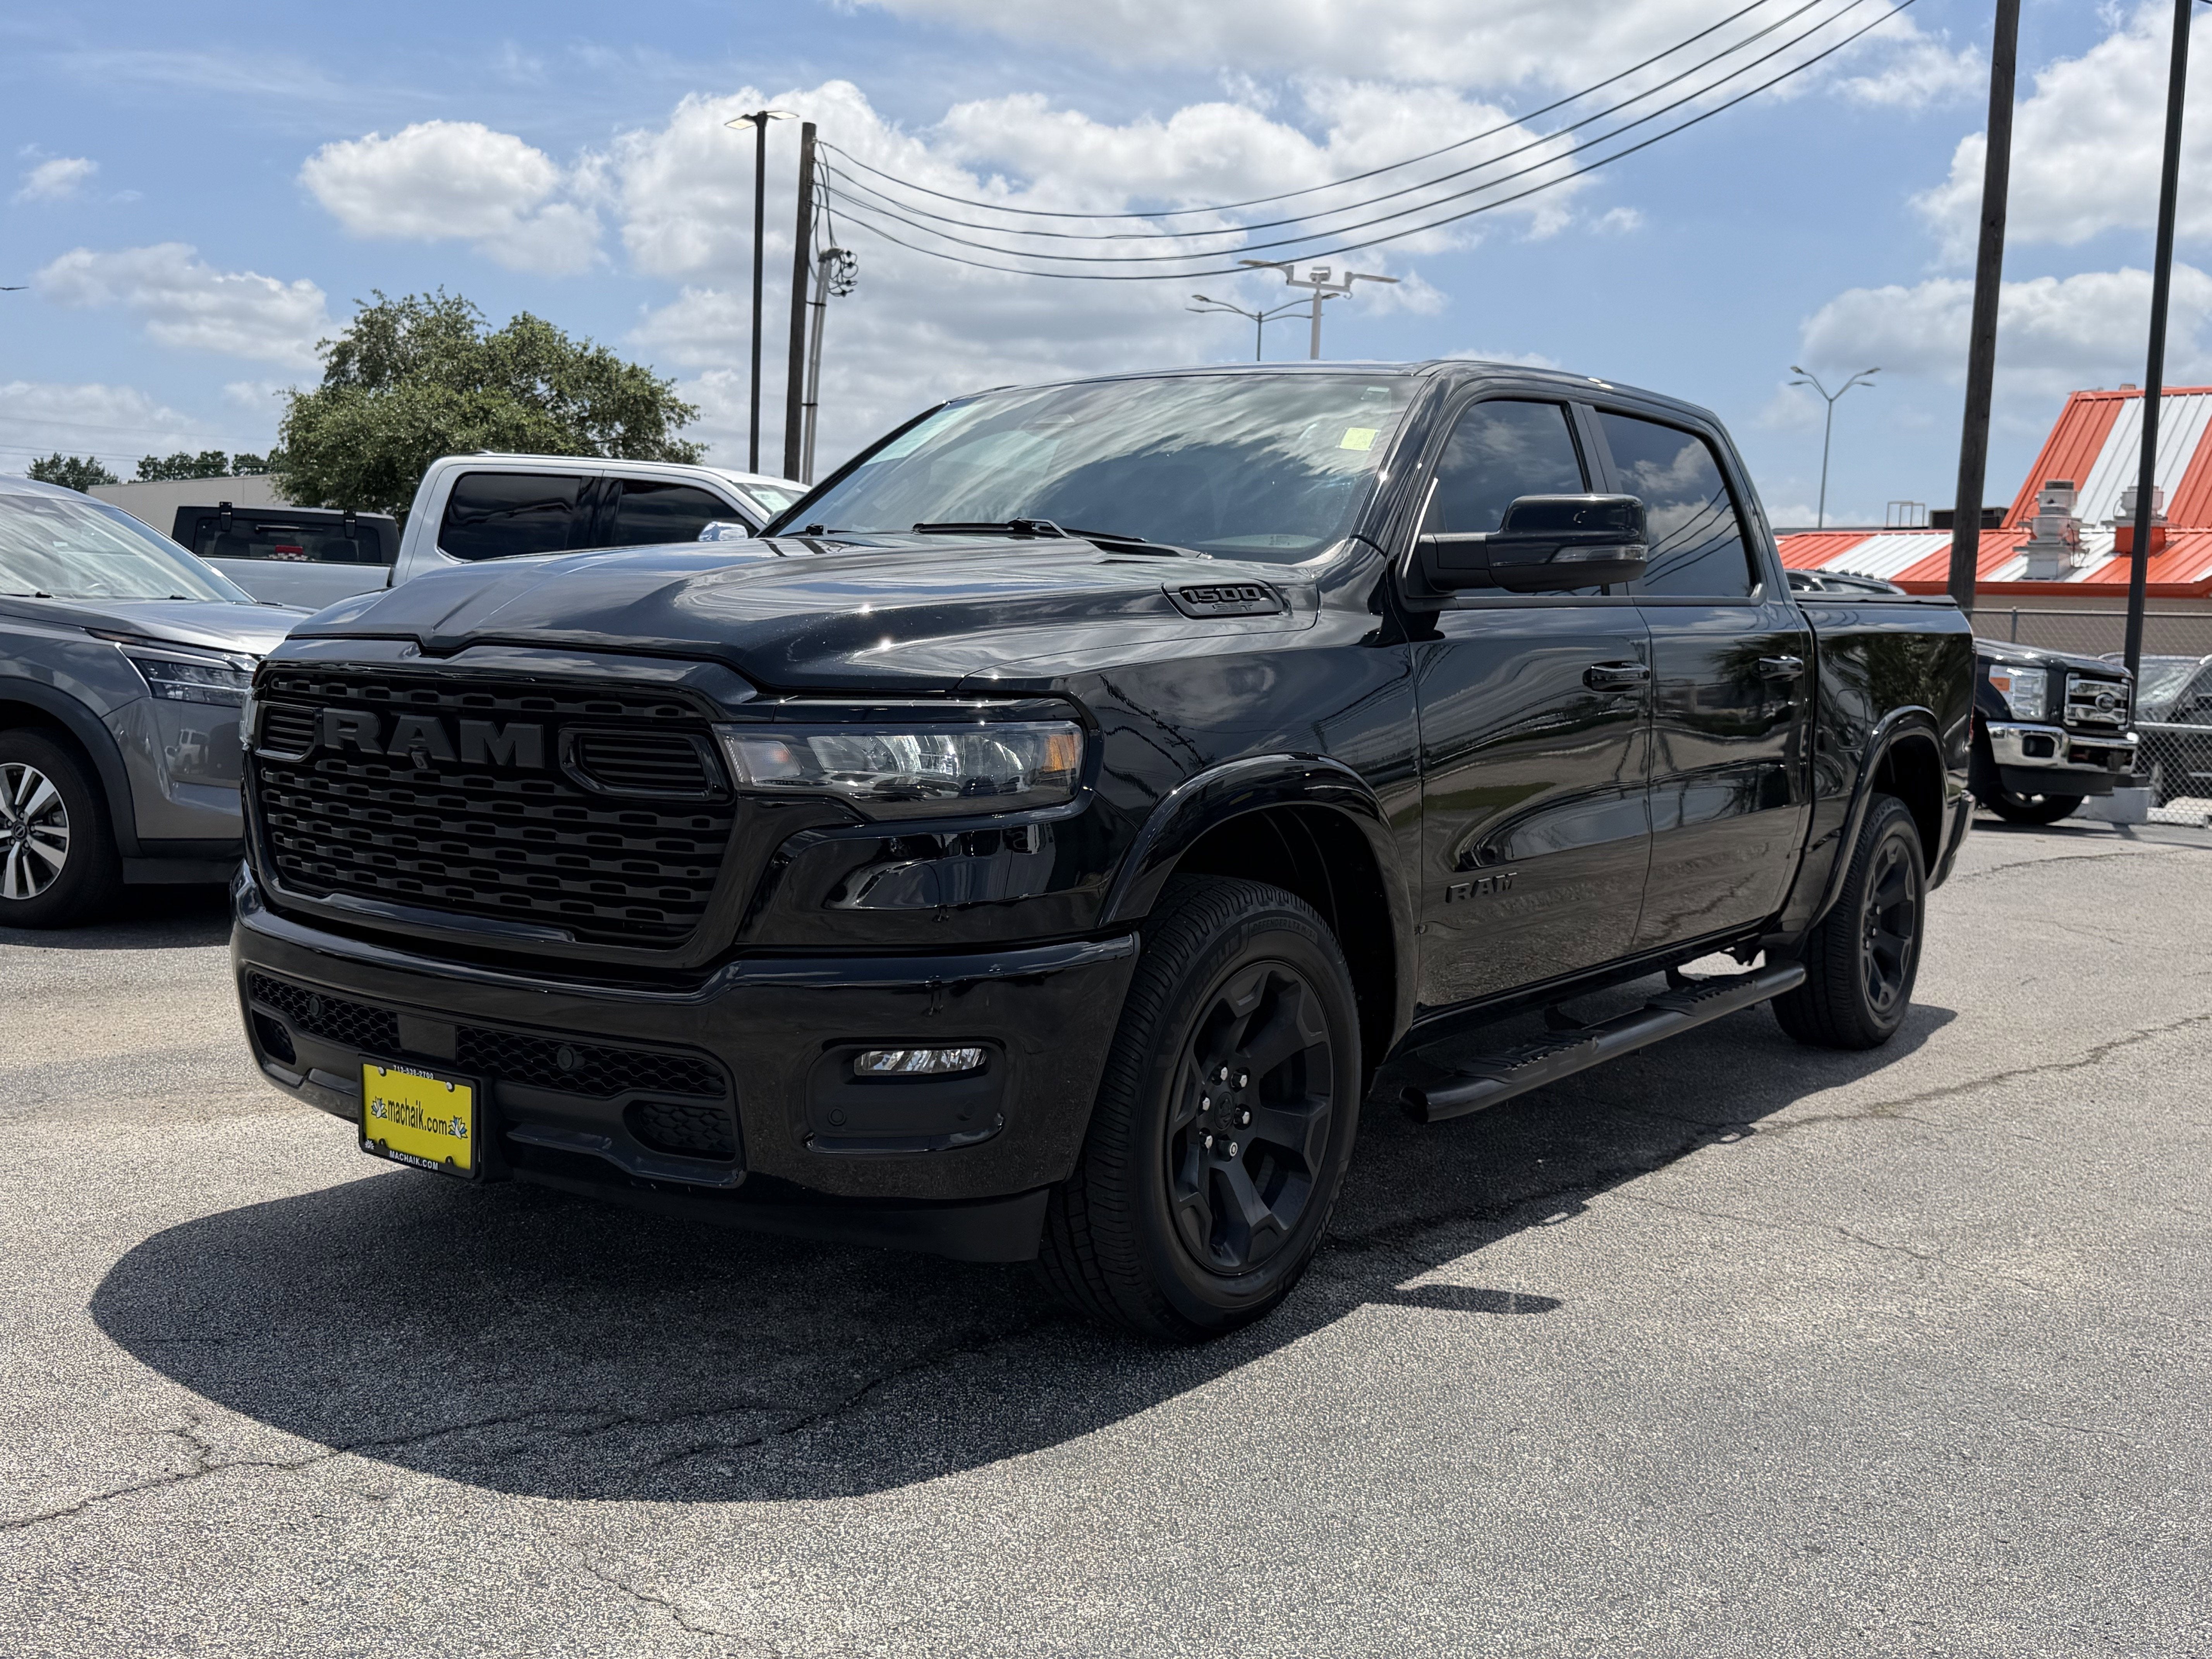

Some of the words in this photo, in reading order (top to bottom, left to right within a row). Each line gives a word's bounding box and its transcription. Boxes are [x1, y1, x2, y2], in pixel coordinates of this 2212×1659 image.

[1181, 587, 1261, 602] 1500
[323, 708, 544, 768] RAM
[1446, 872, 1517, 903] RAM
[1251, 919, 1287, 933] DEFENDER
[1180, 933, 1240, 1022] MICHELIN
[388, 1097, 447, 1135] machaik.com
[390, 1150, 438, 1170] MACHAIK.COM
